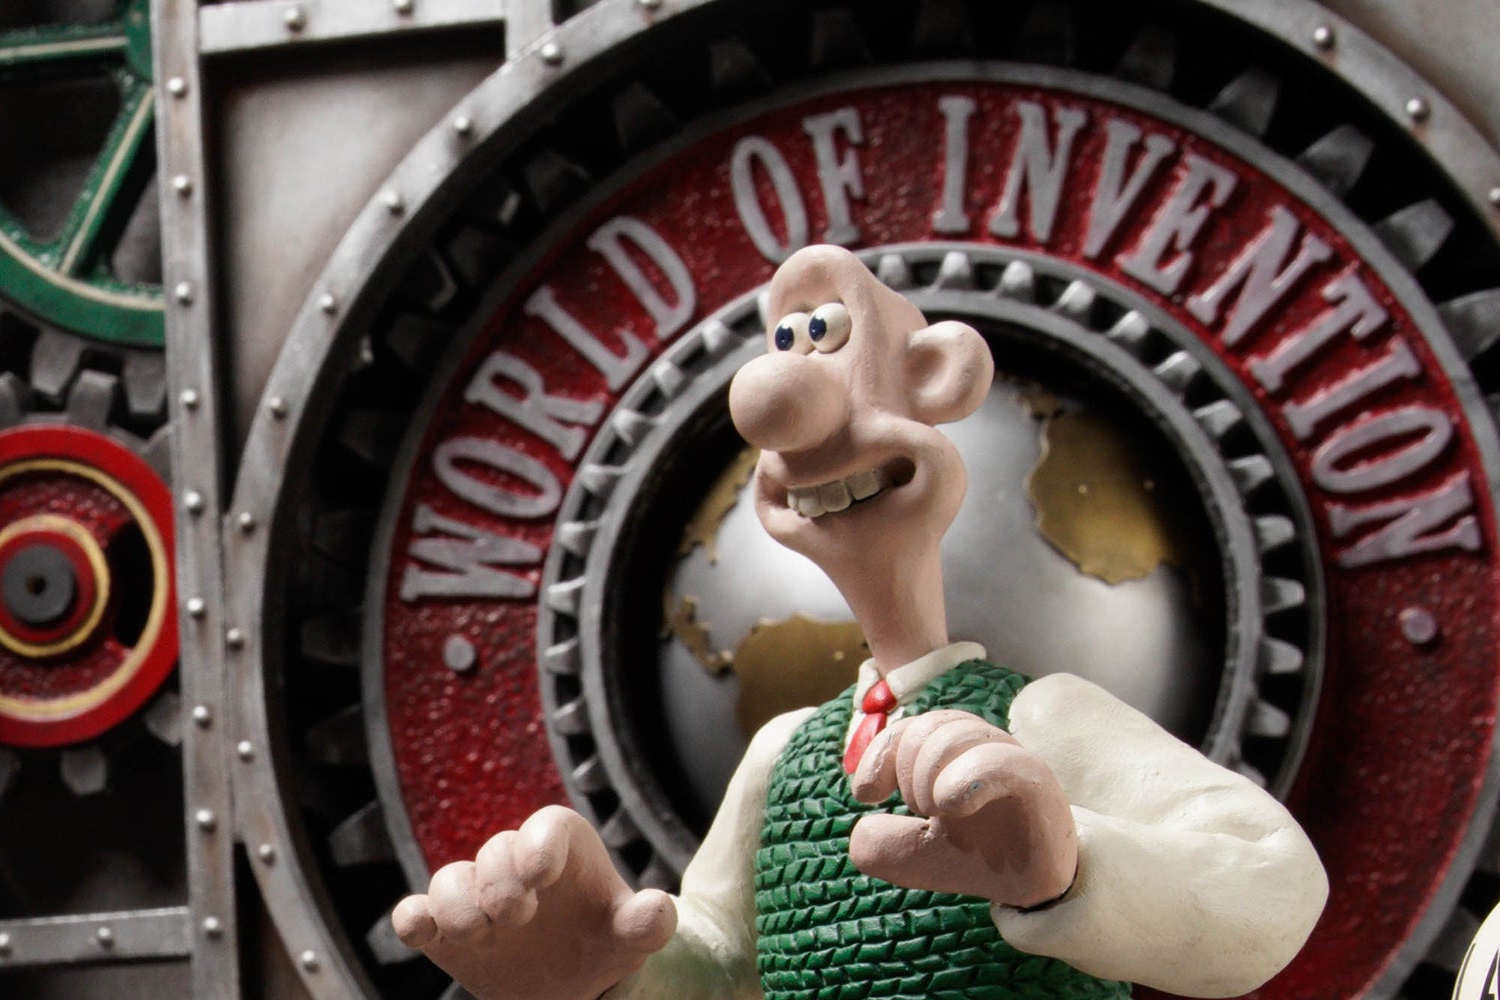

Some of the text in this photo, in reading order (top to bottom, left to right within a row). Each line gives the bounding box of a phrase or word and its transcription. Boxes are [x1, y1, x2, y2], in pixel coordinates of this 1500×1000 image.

[402, 95, 1481, 601] WORLD OF INVENTION
